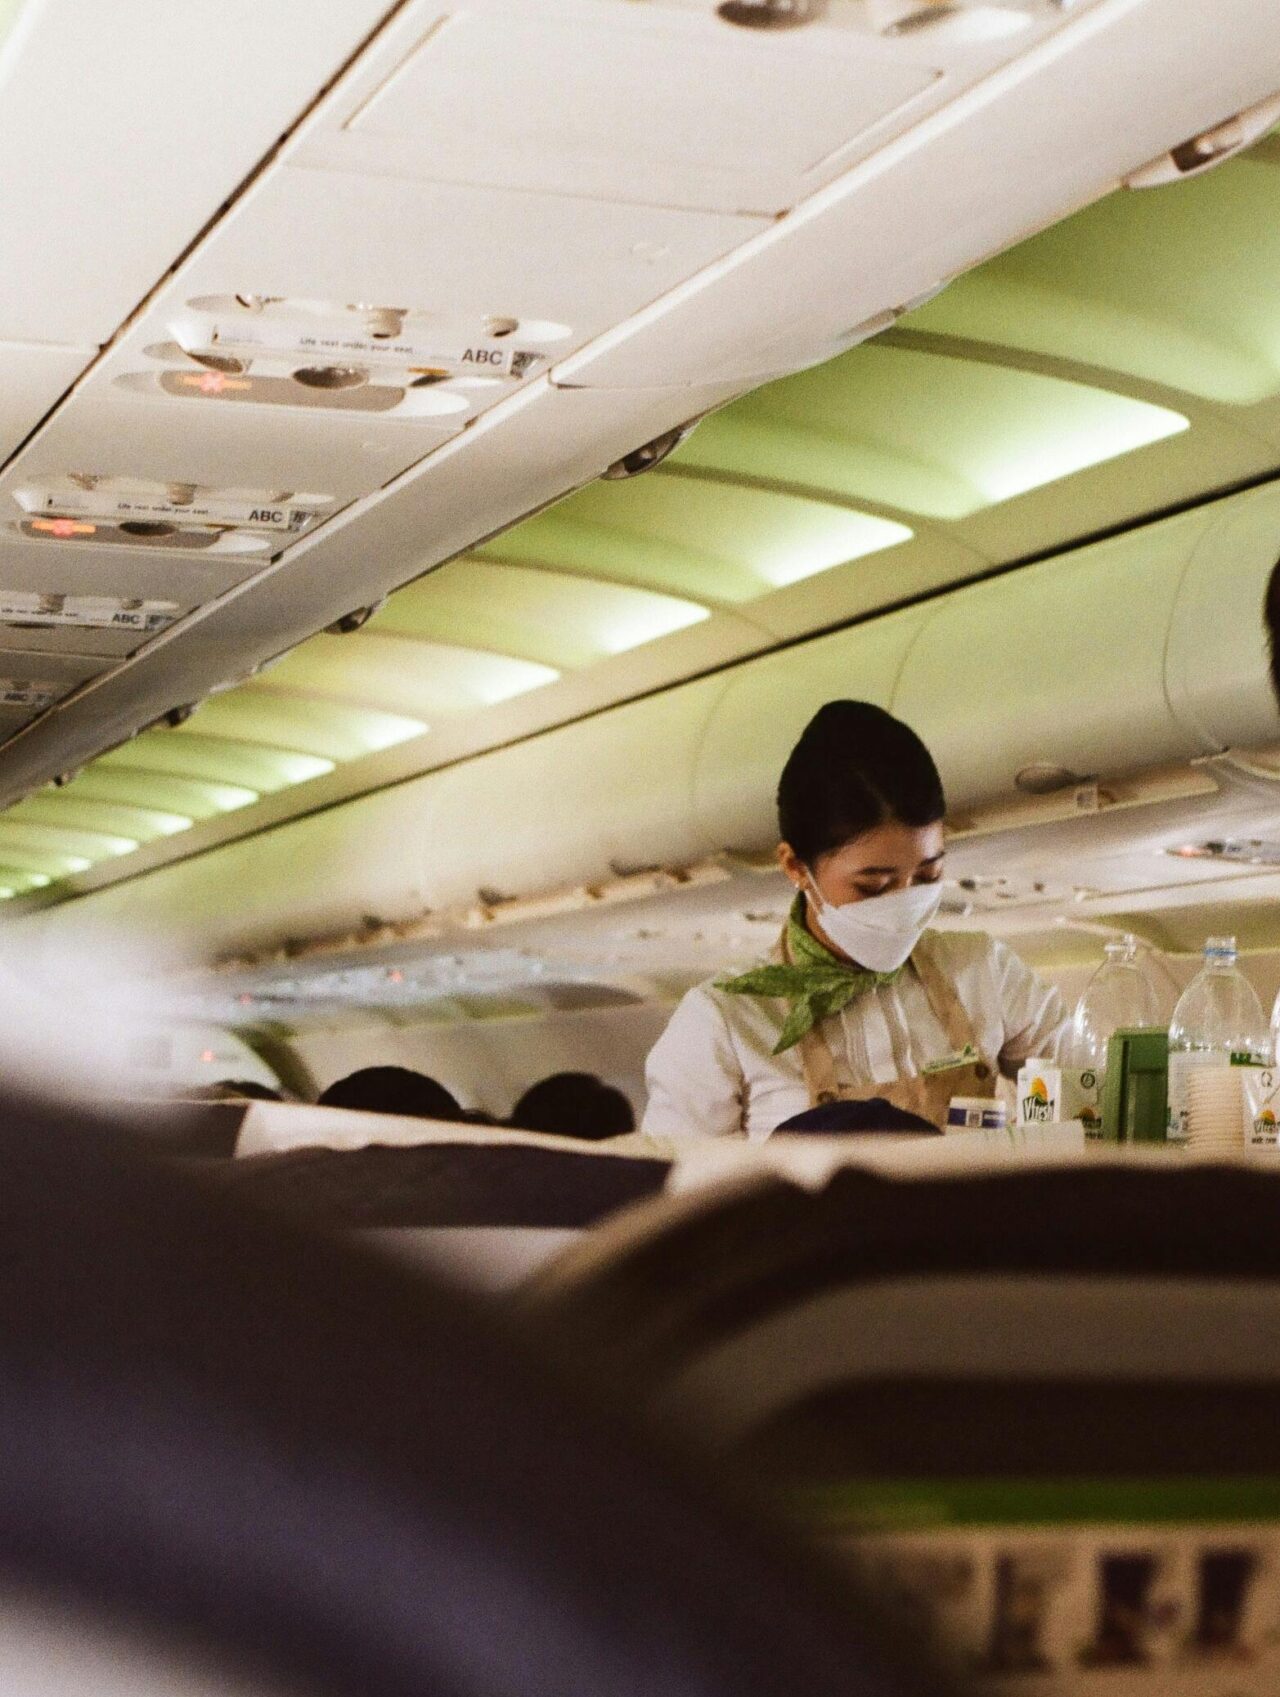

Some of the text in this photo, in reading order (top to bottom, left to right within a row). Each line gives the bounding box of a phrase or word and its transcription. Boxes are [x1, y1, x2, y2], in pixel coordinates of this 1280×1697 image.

[462, 348, 503, 366] ABC
[249, 510, 283, 523] ABC
[111, 613, 140, 625] ABC
